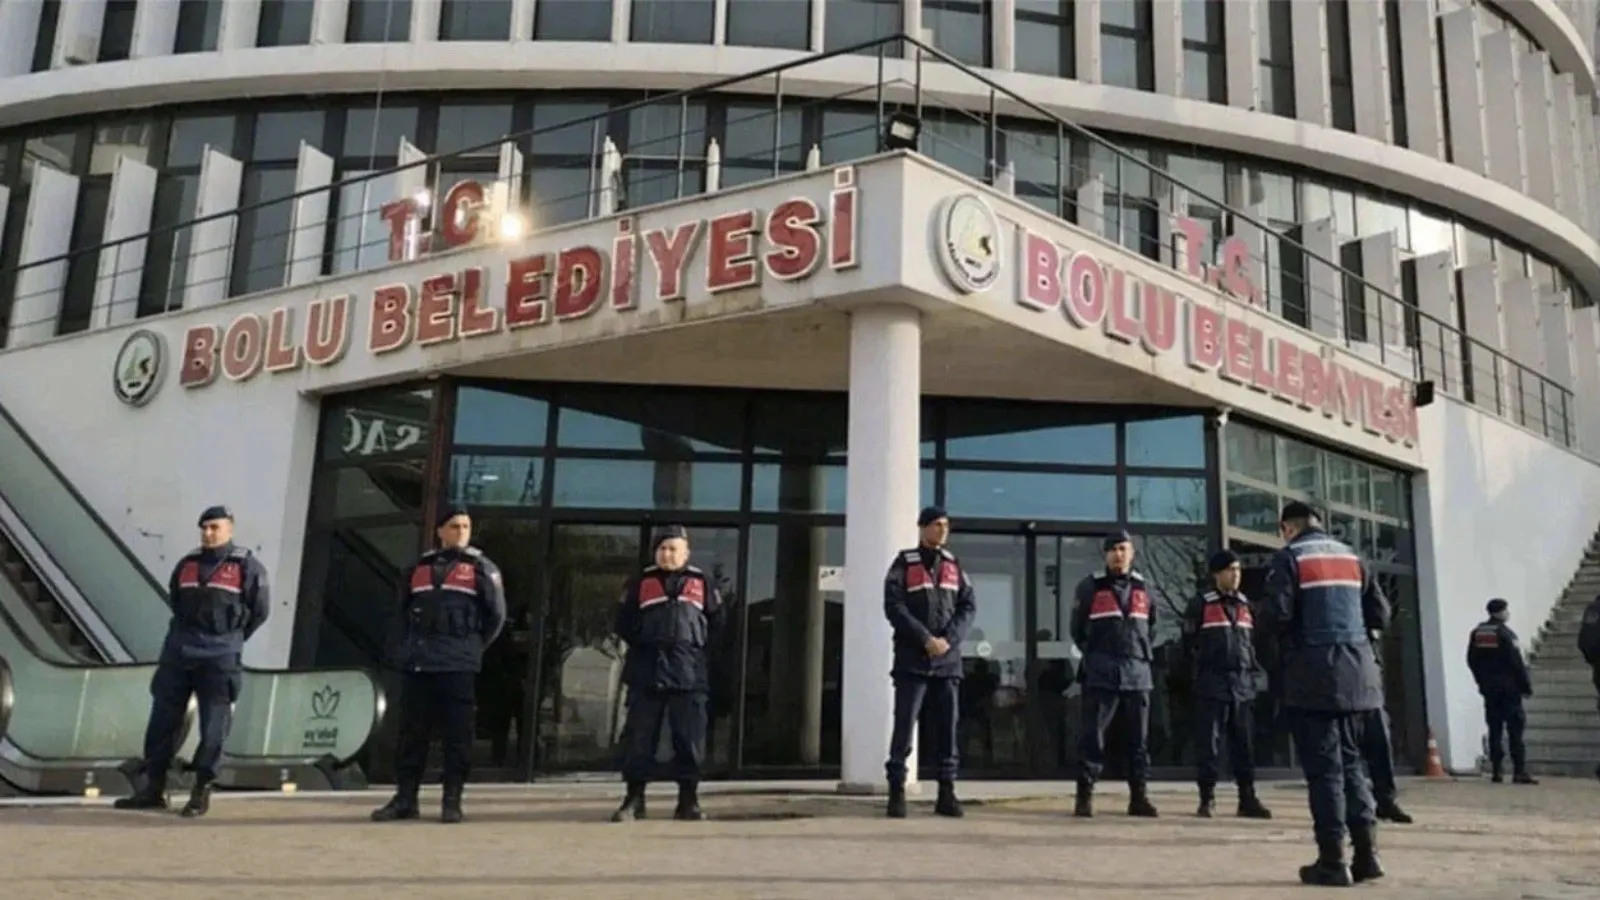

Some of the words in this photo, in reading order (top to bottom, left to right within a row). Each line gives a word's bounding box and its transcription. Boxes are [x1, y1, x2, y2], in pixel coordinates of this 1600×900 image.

[180, 294, 351, 388] BOLU
[369, 166, 859, 354] BELEDİYESİ
[1019, 231, 1177, 355] BOLU
[1189, 304, 1420, 446] BELEDİYESİ
